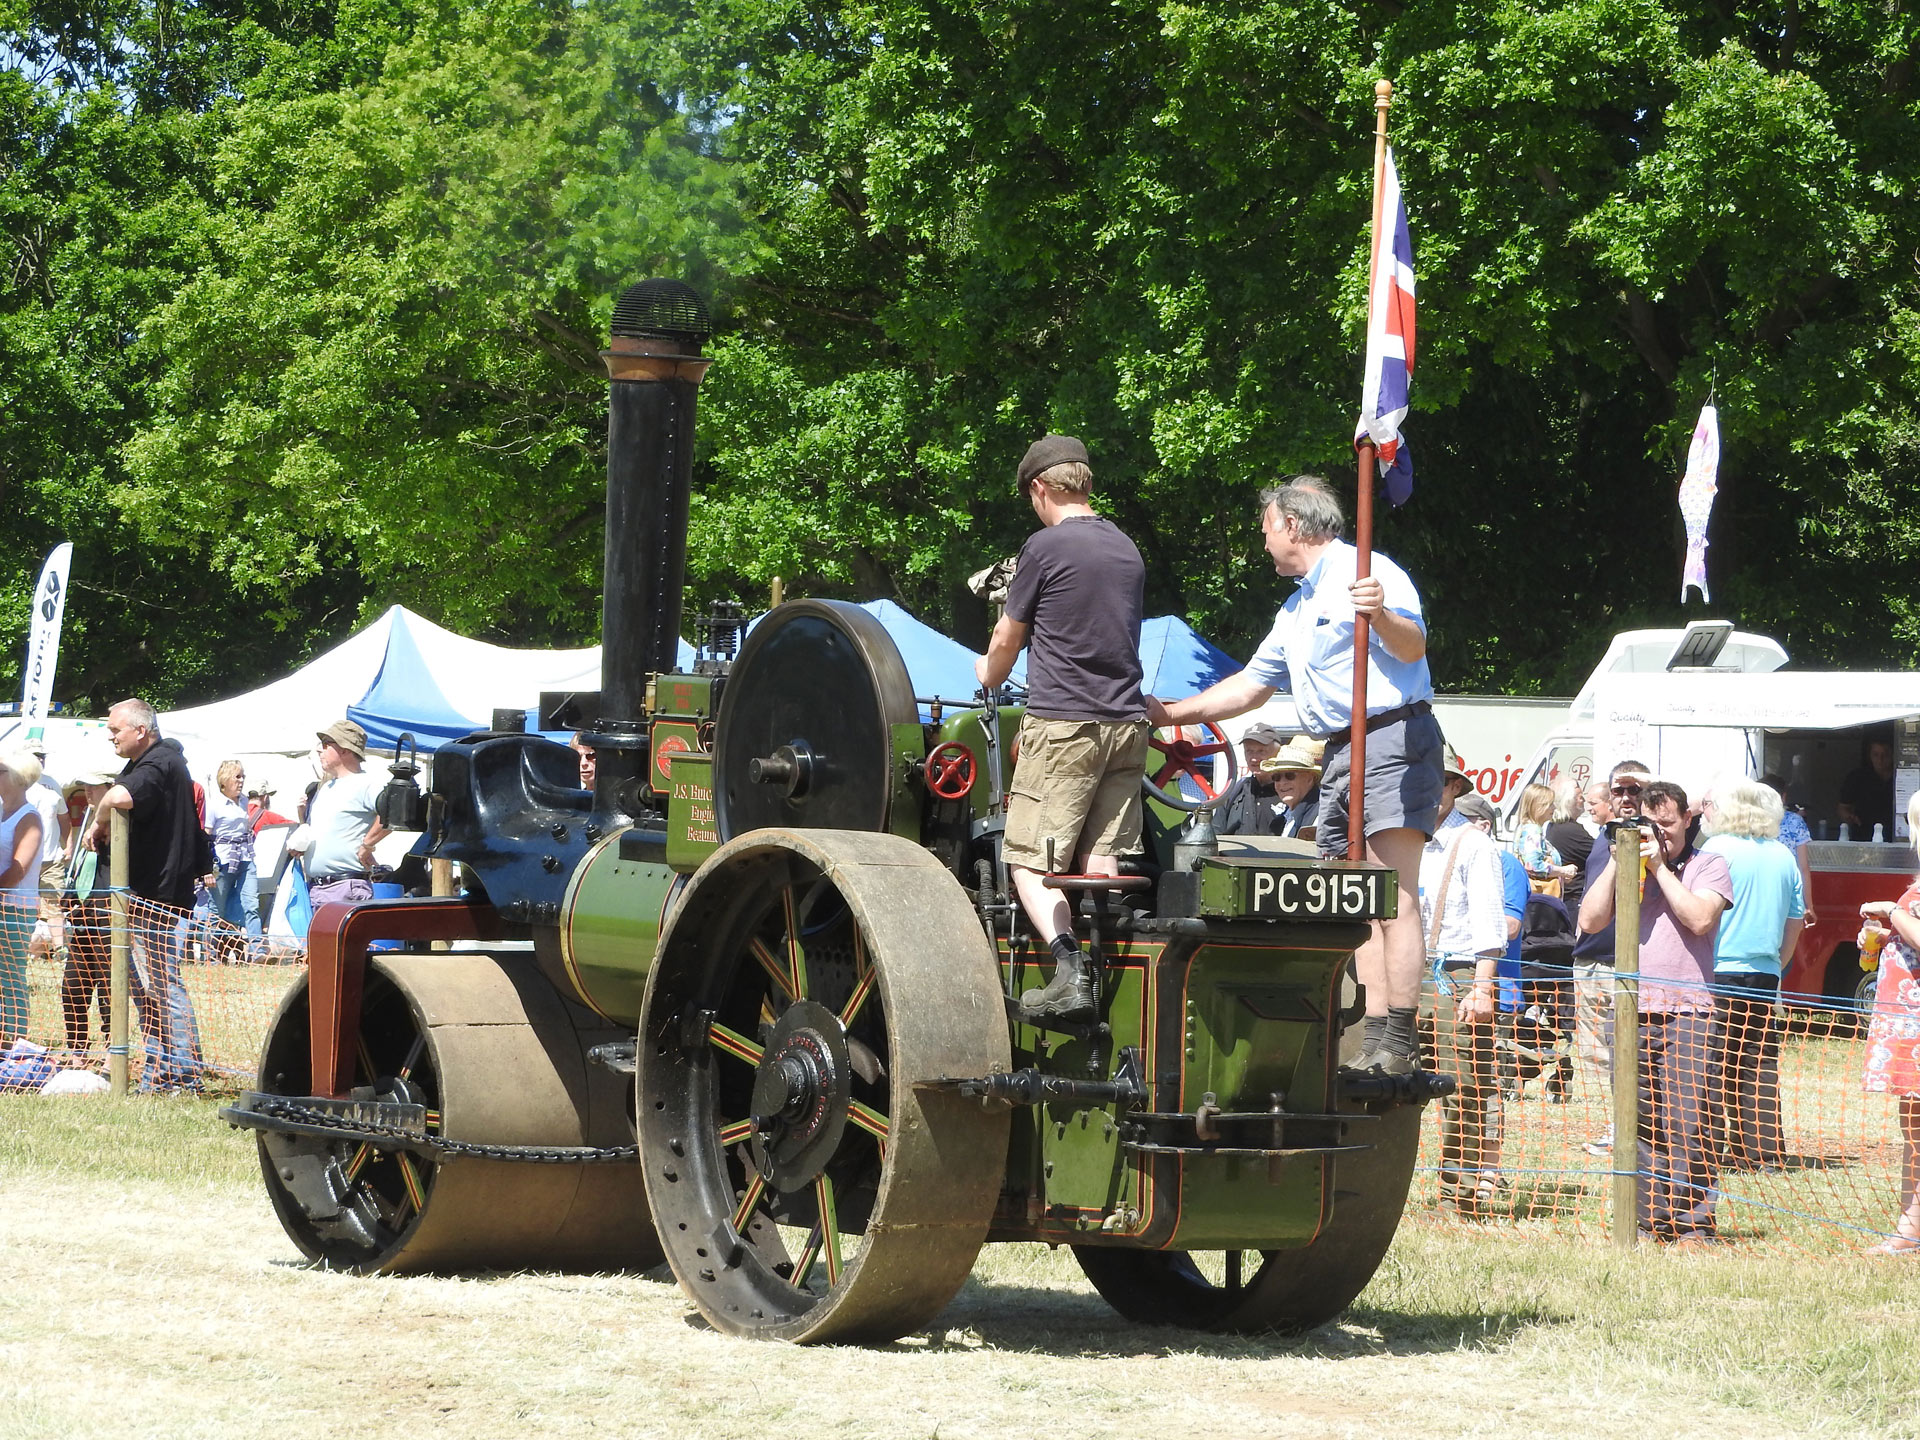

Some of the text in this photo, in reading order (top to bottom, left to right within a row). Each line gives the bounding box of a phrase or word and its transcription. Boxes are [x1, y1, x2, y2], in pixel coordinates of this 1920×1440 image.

[1609, 711, 1646, 726] Quality
[674, 783, 688, 799] J.S.
[1253, 872, 1376, 914] PC 9151
